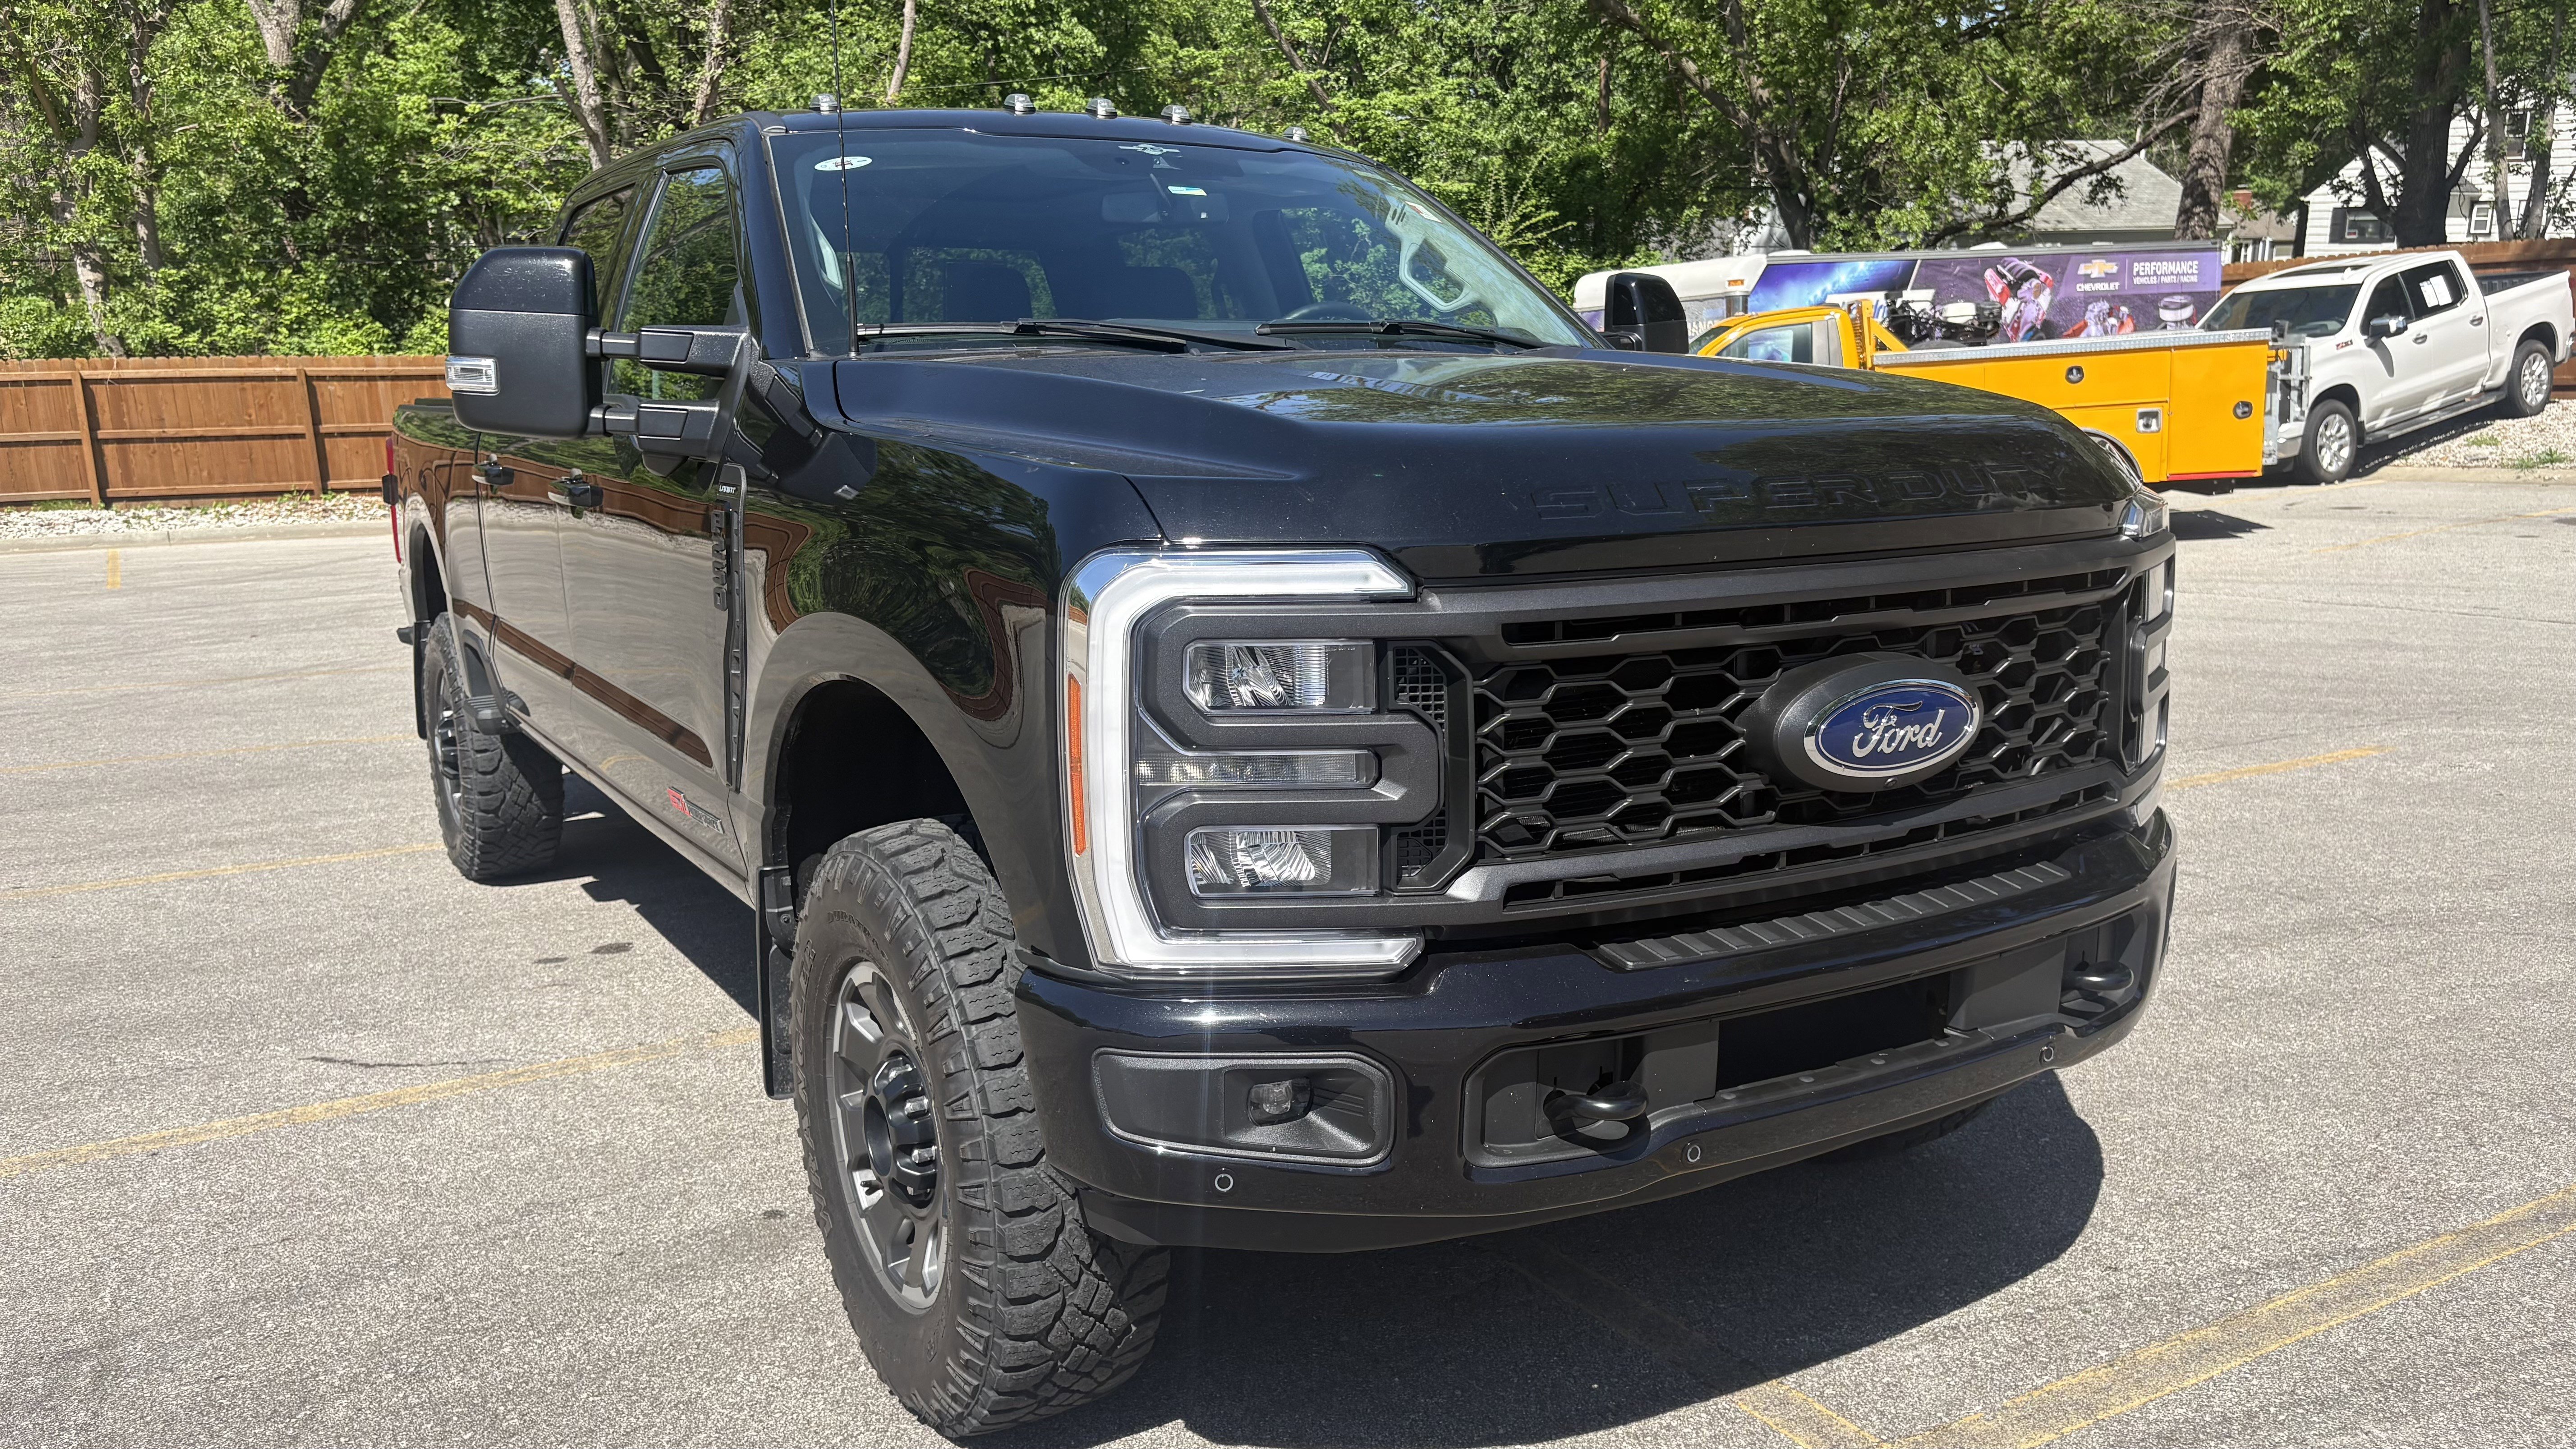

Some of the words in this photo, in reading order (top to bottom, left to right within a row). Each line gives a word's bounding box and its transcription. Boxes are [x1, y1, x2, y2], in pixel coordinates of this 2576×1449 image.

[2076, 282, 2120, 291] CHEVROLET
[2133, 260, 2199, 276] PERFORMANCE
[1852, 700, 1945, 758] Ford
[795, 938, 833, 1237] WRANGLER
